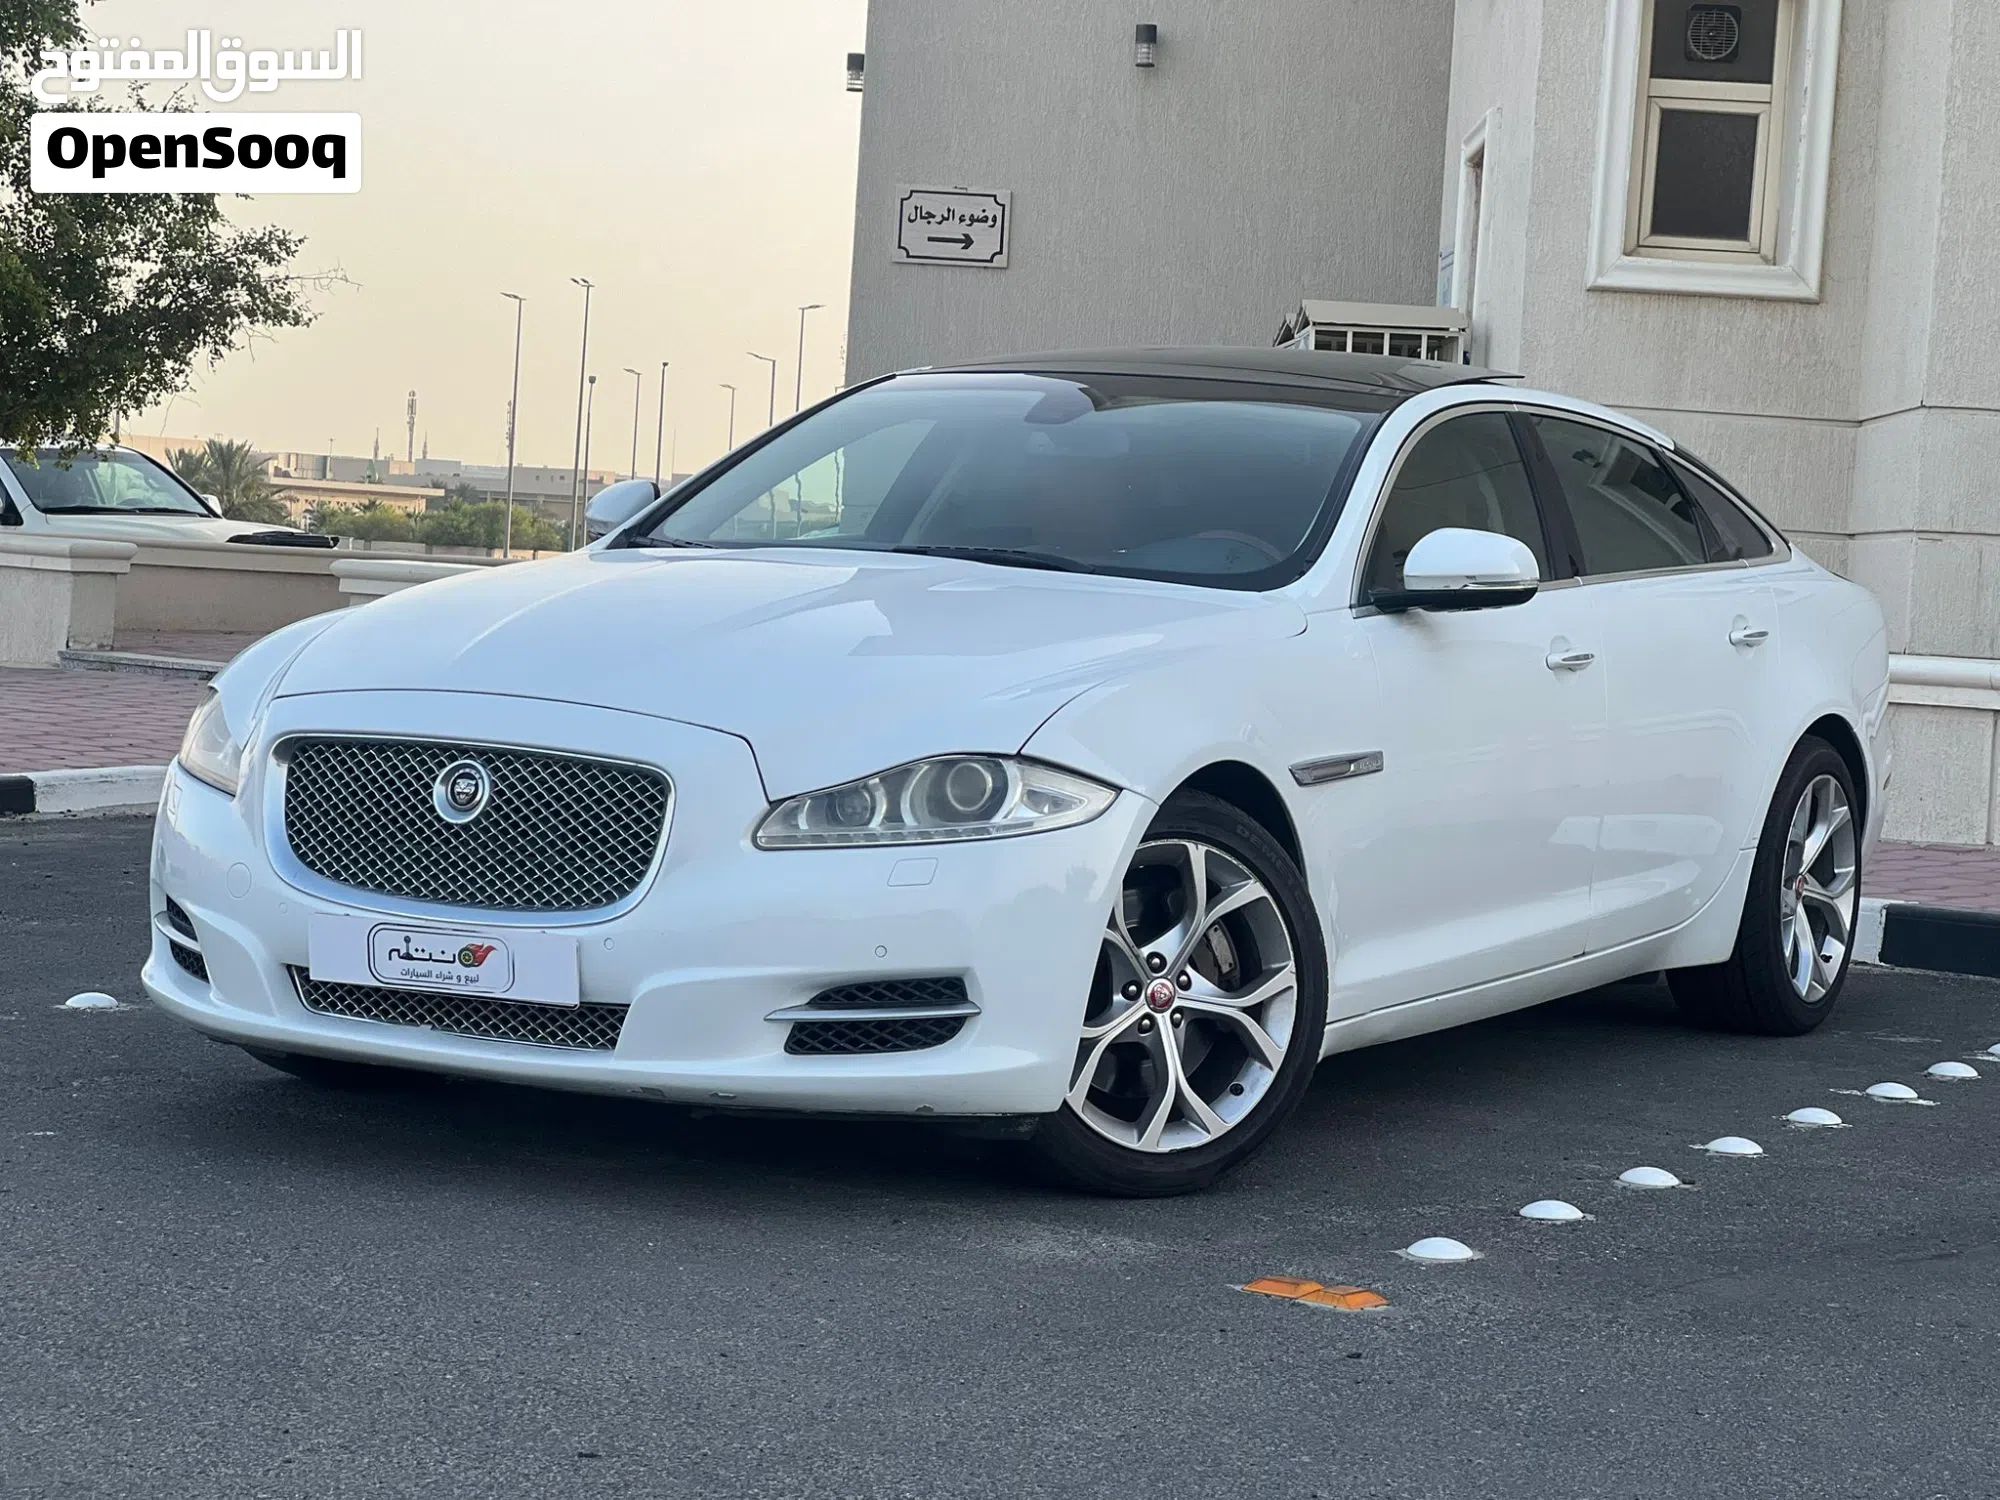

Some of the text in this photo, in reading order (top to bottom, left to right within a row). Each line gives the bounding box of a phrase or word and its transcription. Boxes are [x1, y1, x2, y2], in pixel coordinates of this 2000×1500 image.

[907, 205, 998, 228] وضوء الرجال
[400, 968, 480, 984] لبيع و شراء السيارات
